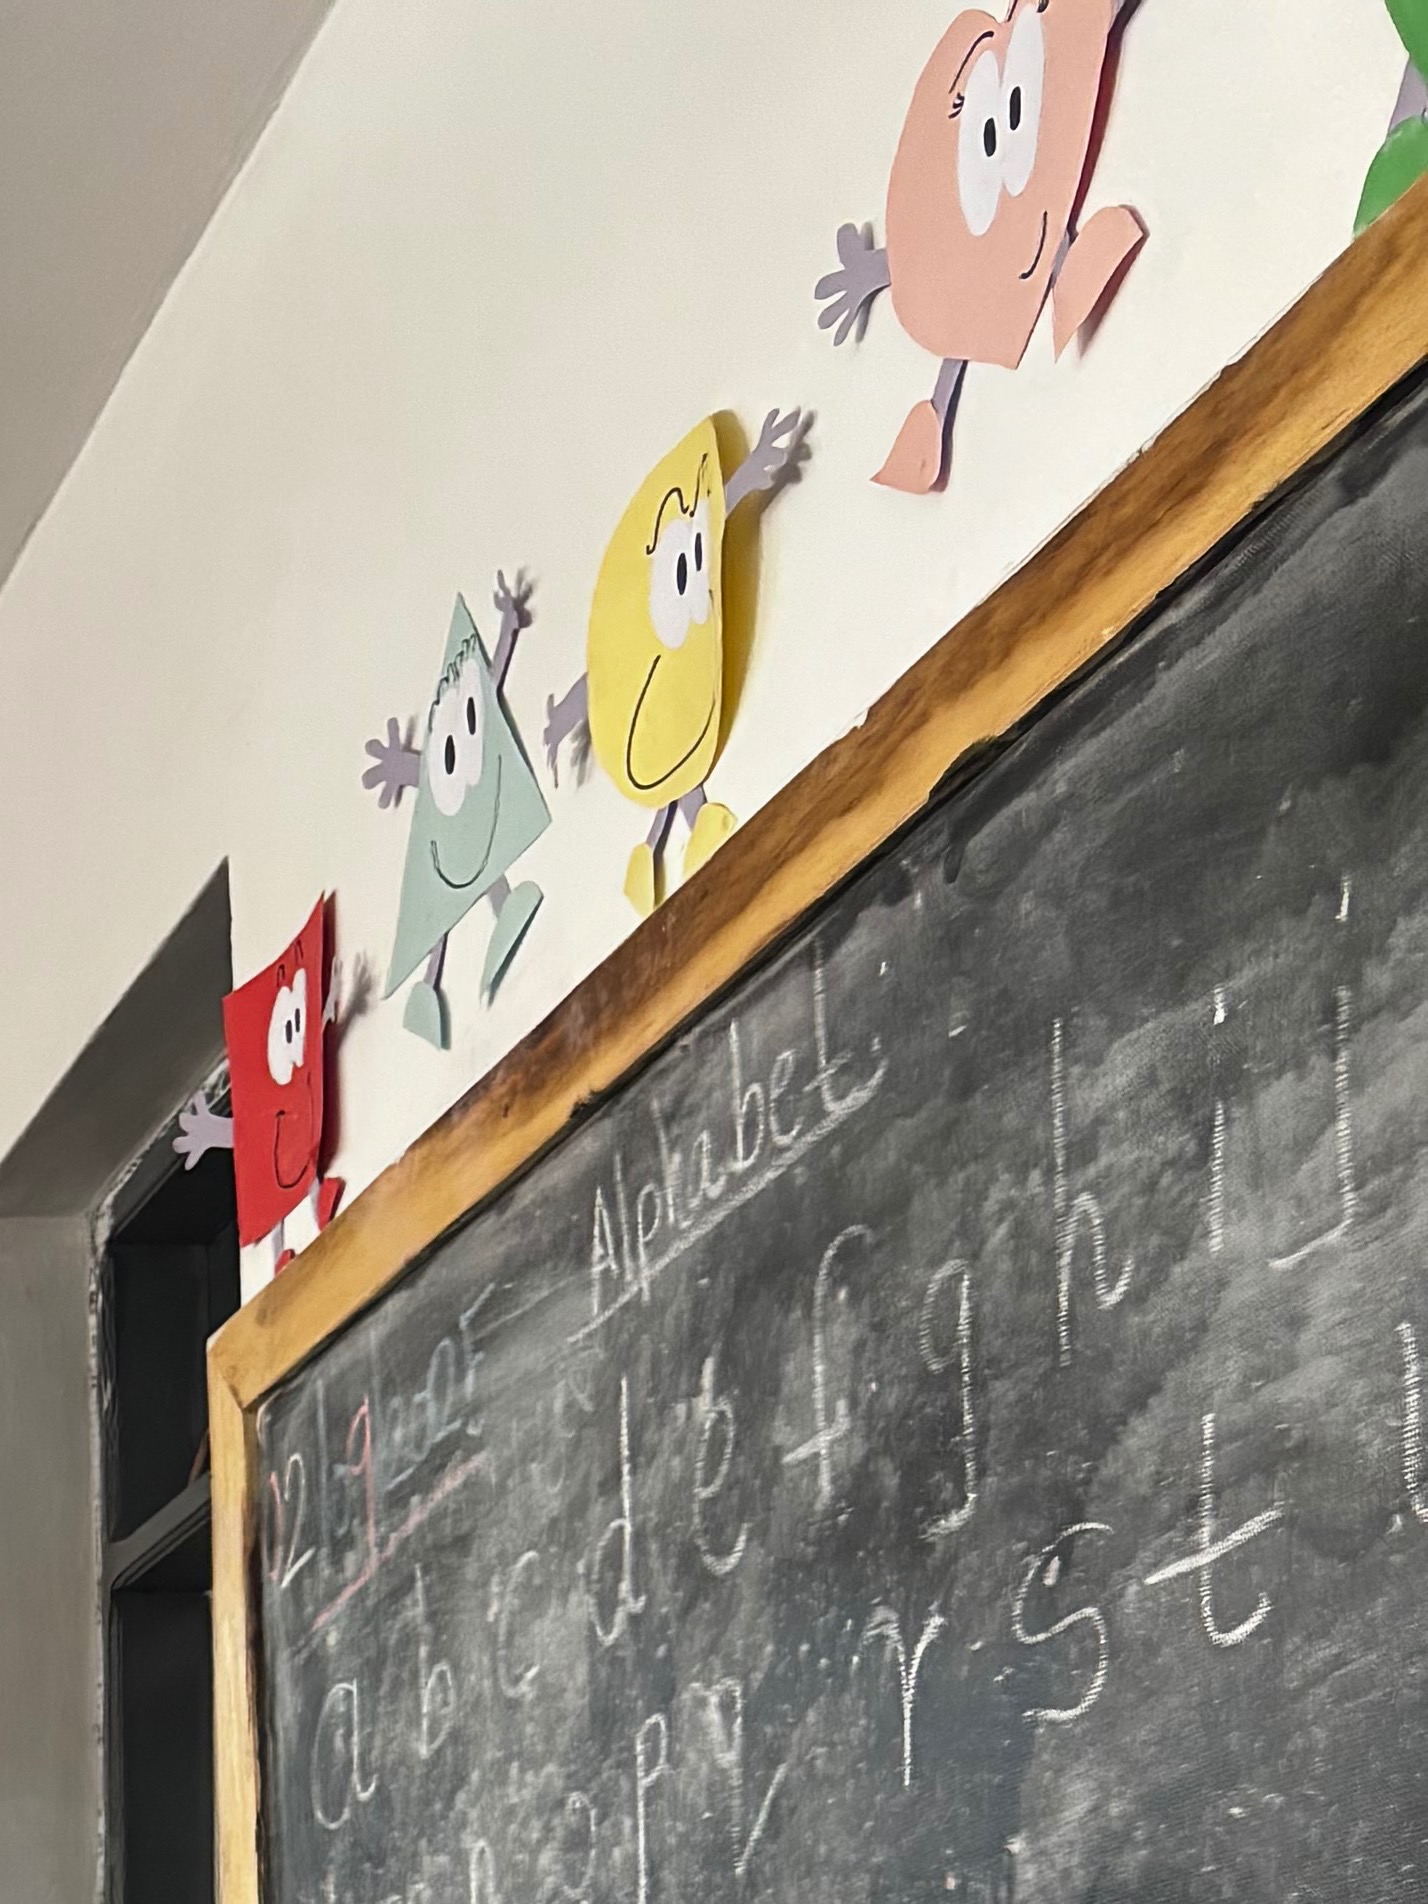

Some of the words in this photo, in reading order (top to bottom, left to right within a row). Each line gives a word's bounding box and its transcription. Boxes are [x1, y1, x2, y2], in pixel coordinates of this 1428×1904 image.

[312, 1680, 377, 1829] a
[414, 1562, 453, 1758] b
[492, 1550, 540, 1699] c
[579, 1375, 646, 1647] d
[782, 1223, 876, 1512] f
[918, 1258, 977, 1540] g
[1048, 1017, 1134, 1367] h
[1208, 983, 1232, 1254] i
[1268, 878, 1357, 1270] j
[587, 935, 888, 1318] Alphabet
[558, 1792, 597, 1900] o
[1143, 1412, 1281, 1647] t
